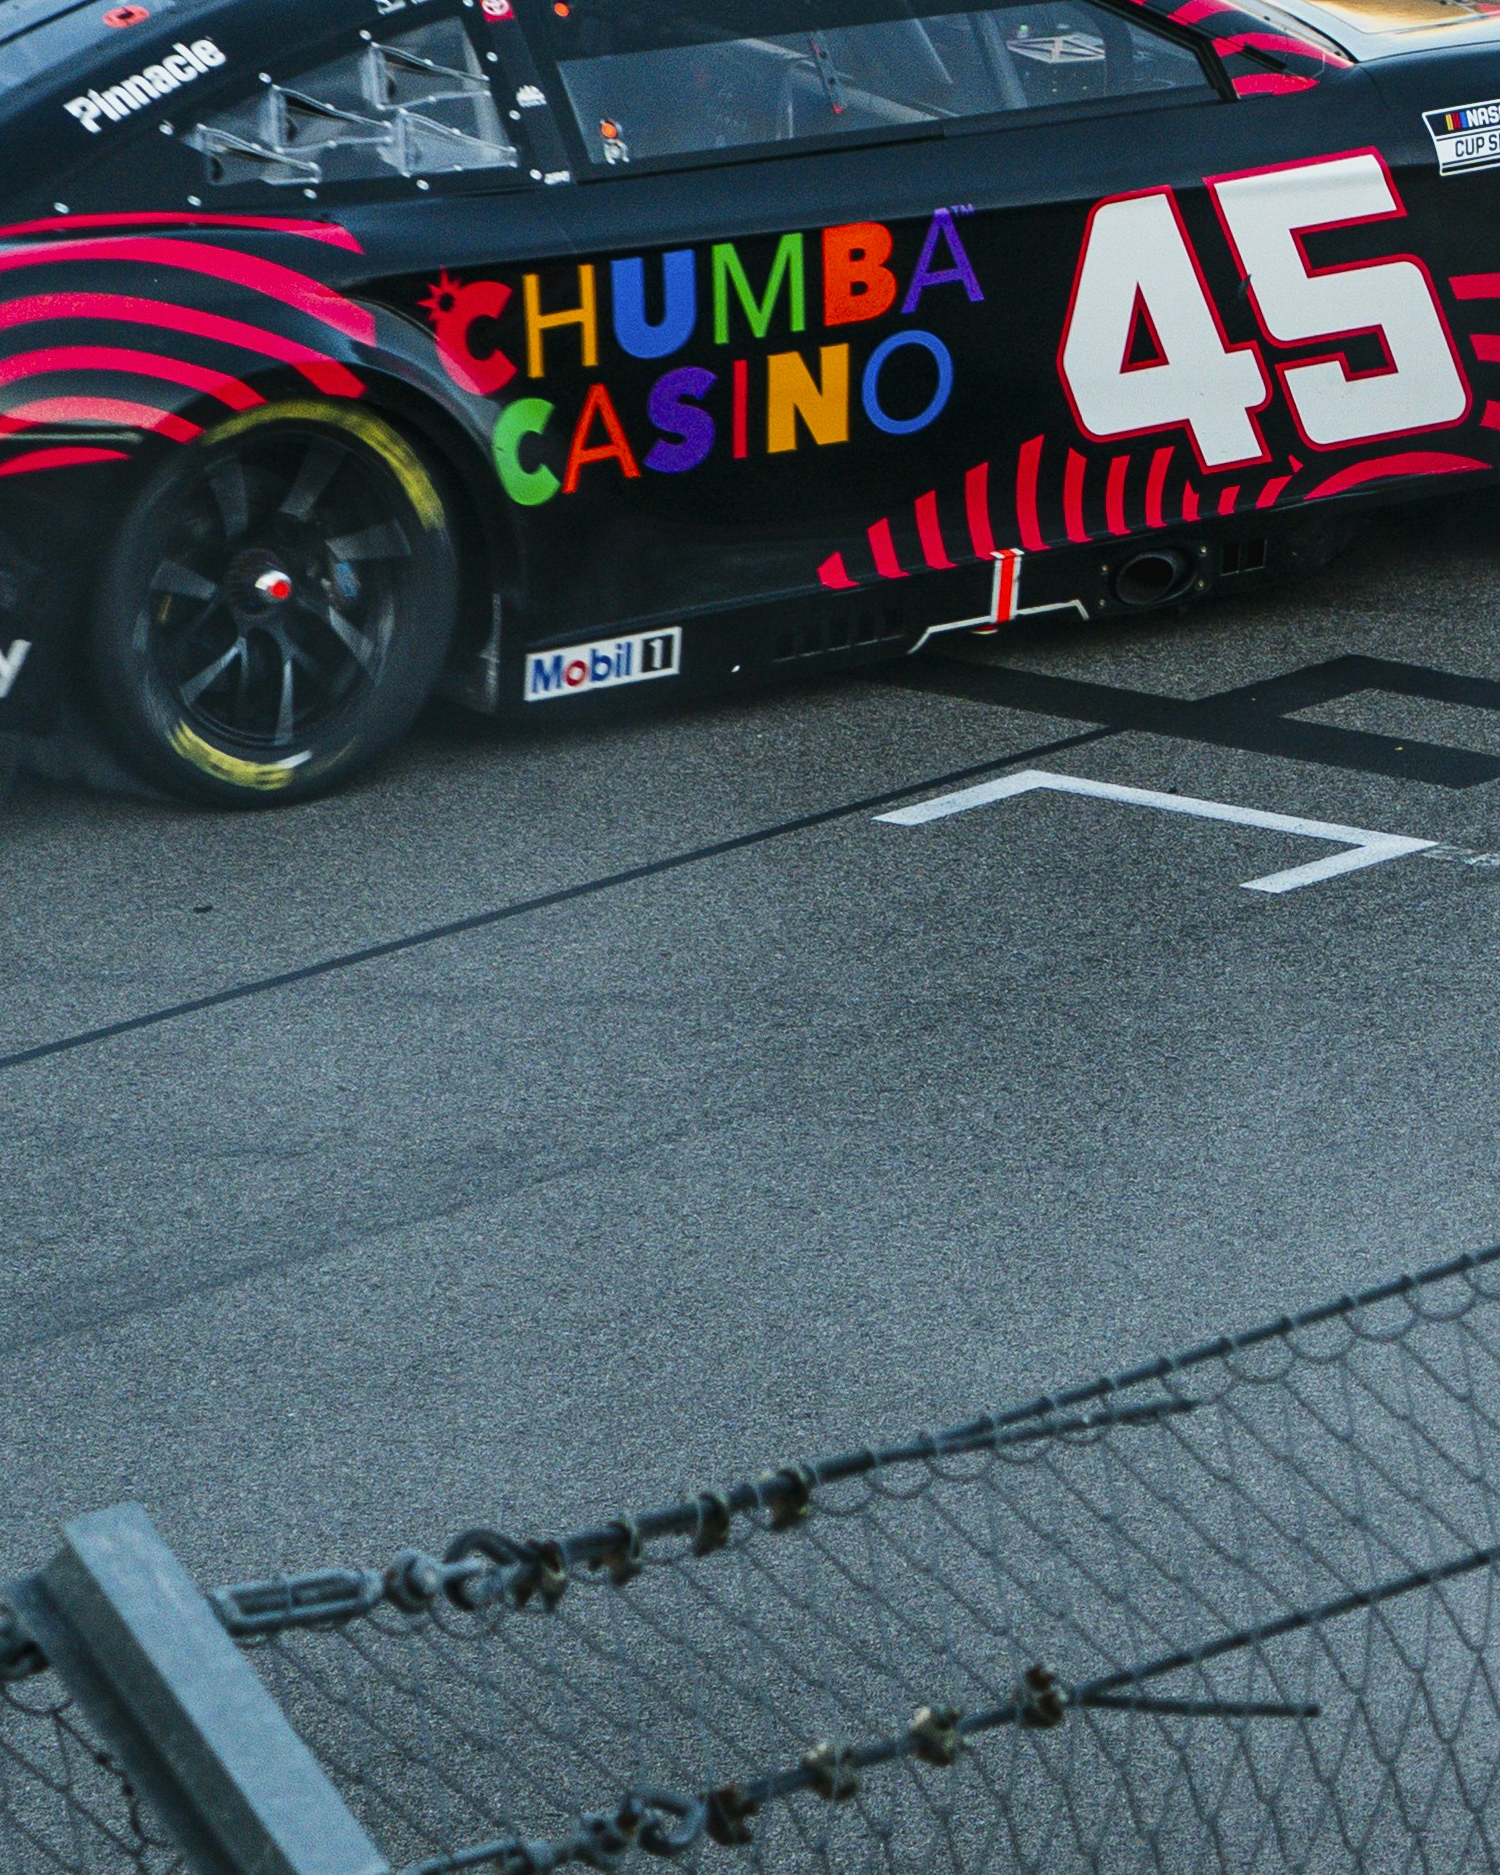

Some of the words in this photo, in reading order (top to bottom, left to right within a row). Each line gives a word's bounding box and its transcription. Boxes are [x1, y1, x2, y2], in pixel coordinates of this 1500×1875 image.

[62, 35, 227, 133] Pinnacle
[1454, 134, 1485, 158] CUP
[416, 207, 985, 396] CHUMBA
[1057, 145, 1474, 475] 45
[491, 329, 954, 507] CASINO
[531, 641, 633, 694] Mobil
[649, 638, 664, 670] 1
